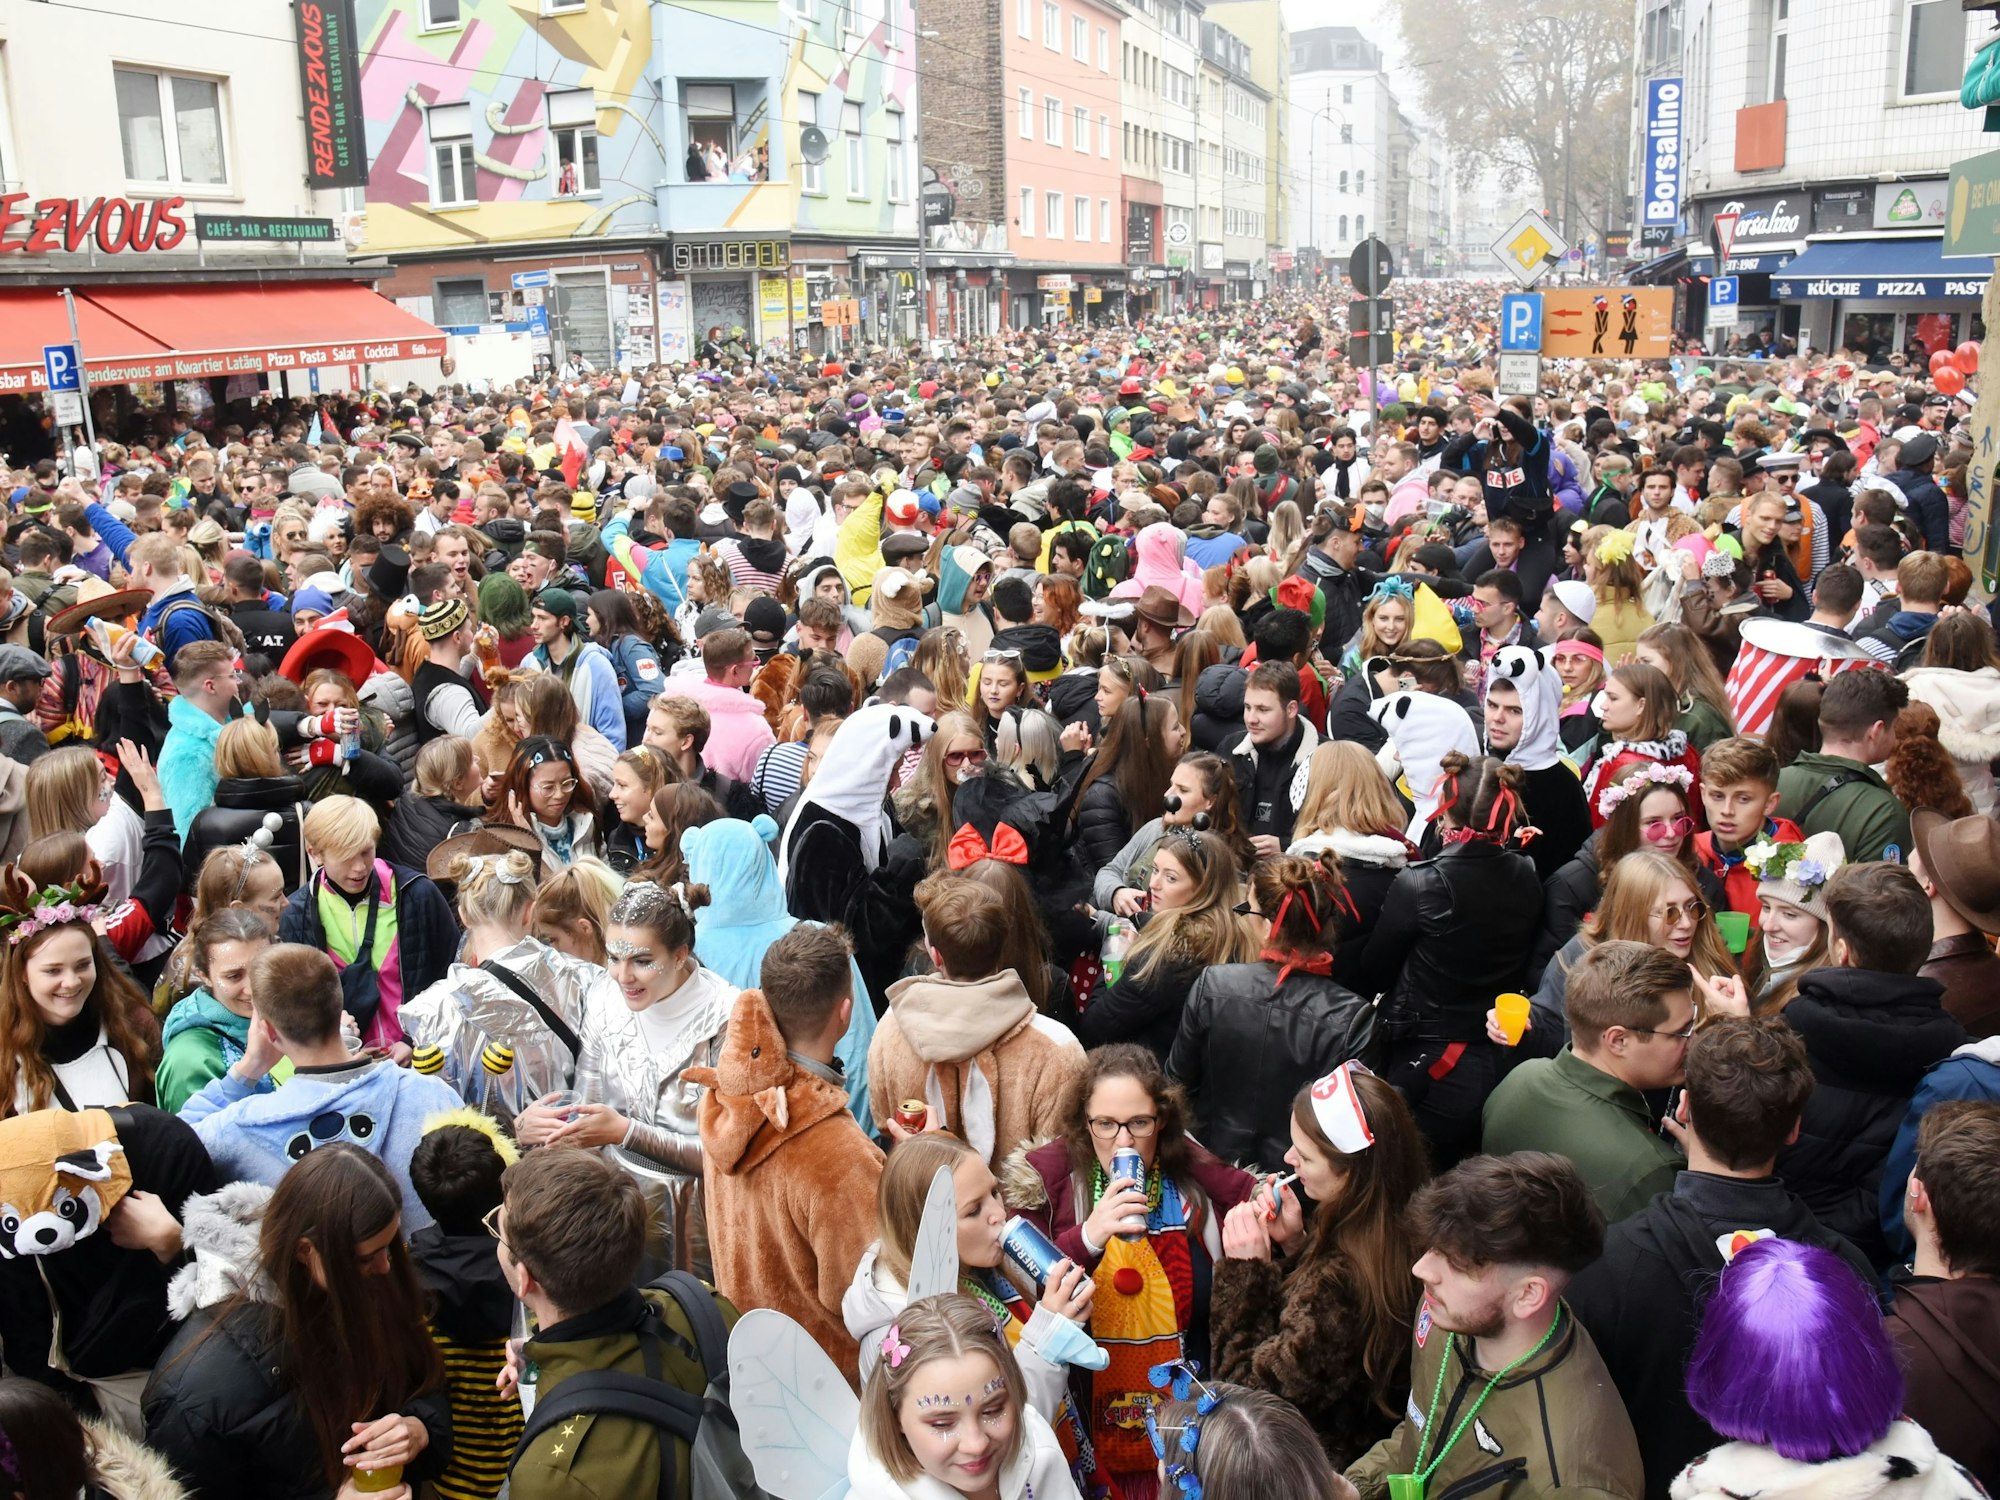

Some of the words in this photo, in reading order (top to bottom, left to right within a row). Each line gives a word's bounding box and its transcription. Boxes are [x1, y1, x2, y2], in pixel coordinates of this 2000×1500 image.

[326, 13, 343, 92] RESTAURANT
[302, 2, 335, 178] RENDEZVOUS
[335, 102, 345, 126] BAR
[335, 137, 349, 167] CAFÉ
[1647, 83, 1681, 220] Borsalino
[206, 220, 232, 238] CAFÉ
[240, 224, 261, 238] BAR
[269, 225, 329, 239] RESTAURANT
[1644, 227, 1669, 242] sky
[675, 244, 789, 268] STIEFEL
[1167, 268, 1182, 278] sky
[1807, 280, 1861, 296] KÜCHE
[1876, 282, 1926, 296] PIZZA
[1715, 281, 1732, 303] P
[1509, 301, 1533, 344] P
[48, 351, 69, 386] P
[155, 363, 172, 377] am
[175, 358, 223, 375] Kwartier
[226, 355, 262, 372] Latäng
[267, 352, 295, 367] Pizza
[300, 350, 327, 364] Pasta
[333, 346, 356, 361] Salat
[364, 343, 399, 358] Cocktail
[1007, 1238, 1041, 1278] ENERGY
